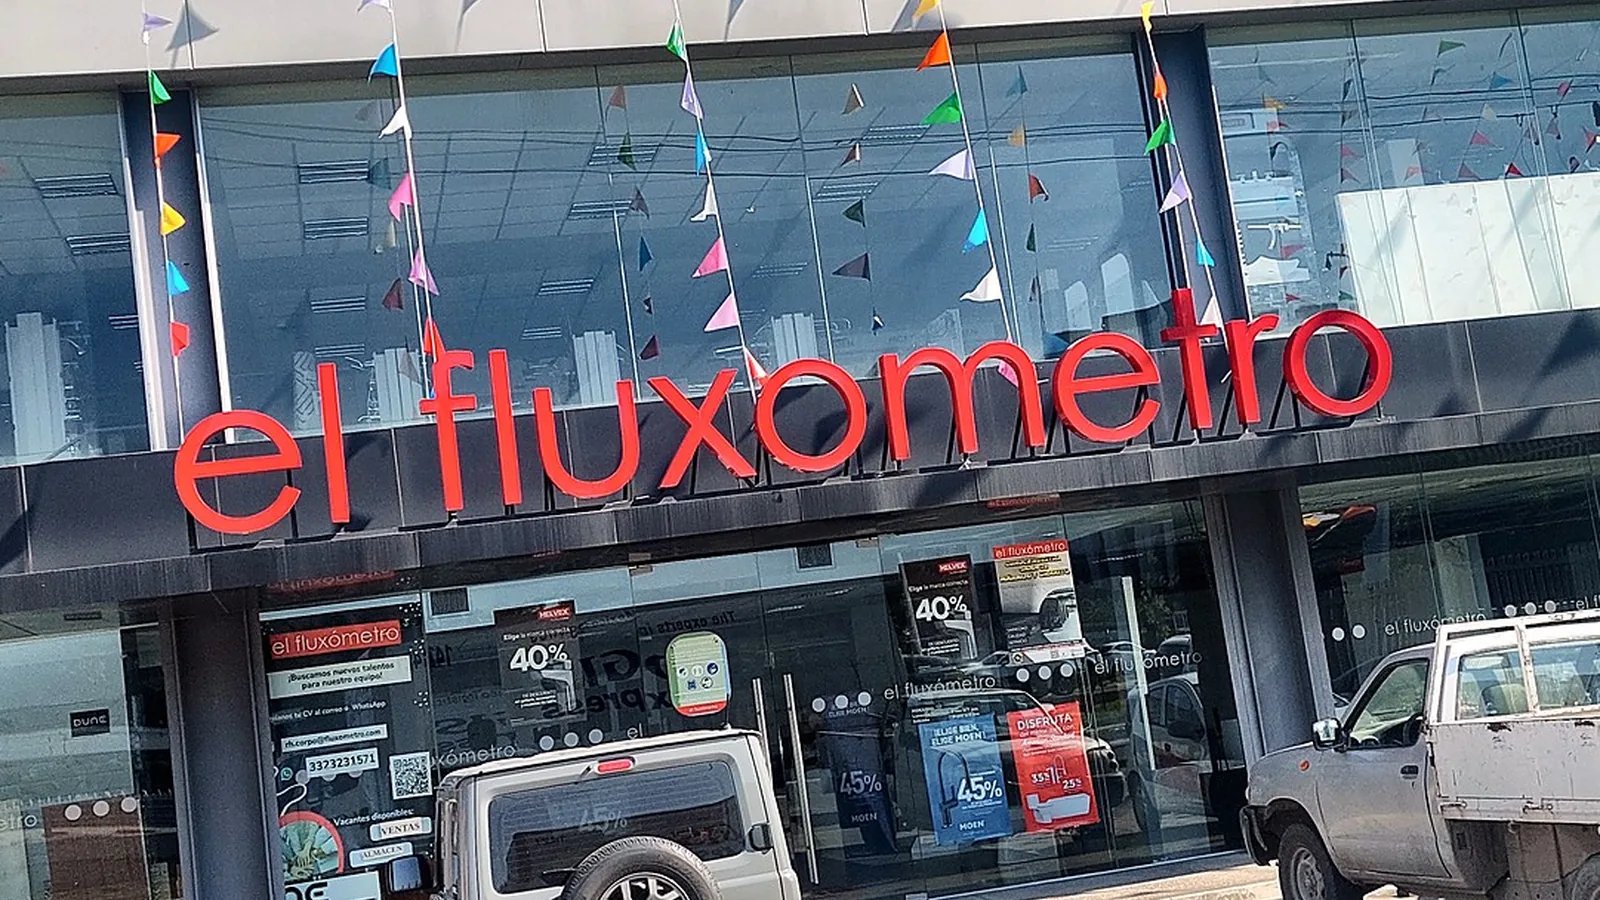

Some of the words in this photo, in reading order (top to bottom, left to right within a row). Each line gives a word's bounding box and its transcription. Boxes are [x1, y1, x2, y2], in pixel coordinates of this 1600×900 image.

[173, 363, 350, 534] el
[420, 288, 1393, 511] fluxometro
[995, 547, 1005, 558] el
[915, 594, 968, 621] 40%
[1384, 621, 1399, 635] el
[272, 638, 290, 655] el
[294, 626, 400, 651] fluxómetro
[509, 643, 568, 672] 40%
[1095, 659, 1110, 674] el
[1114, 651, 1203, 672] fluómetro
[362, 661, 395, 672] talentos
[301, 681, 321, 691] para
[321, 676, 353, 687] nuestro
[884, 683, 900, 700] el
[302, 709, 314, 718] CV
[1017, 713, 1073, 731] DISFRUTA
[626, 722, 643, 739] el
[839, 770, 882, 796] 45%
[957, 776, 1003, 802] 45%
[333, 815, 370, 826] Vacantes
[381, 822, 421, 836] VENTAS
[959, 819, 985, 831] MOEN
